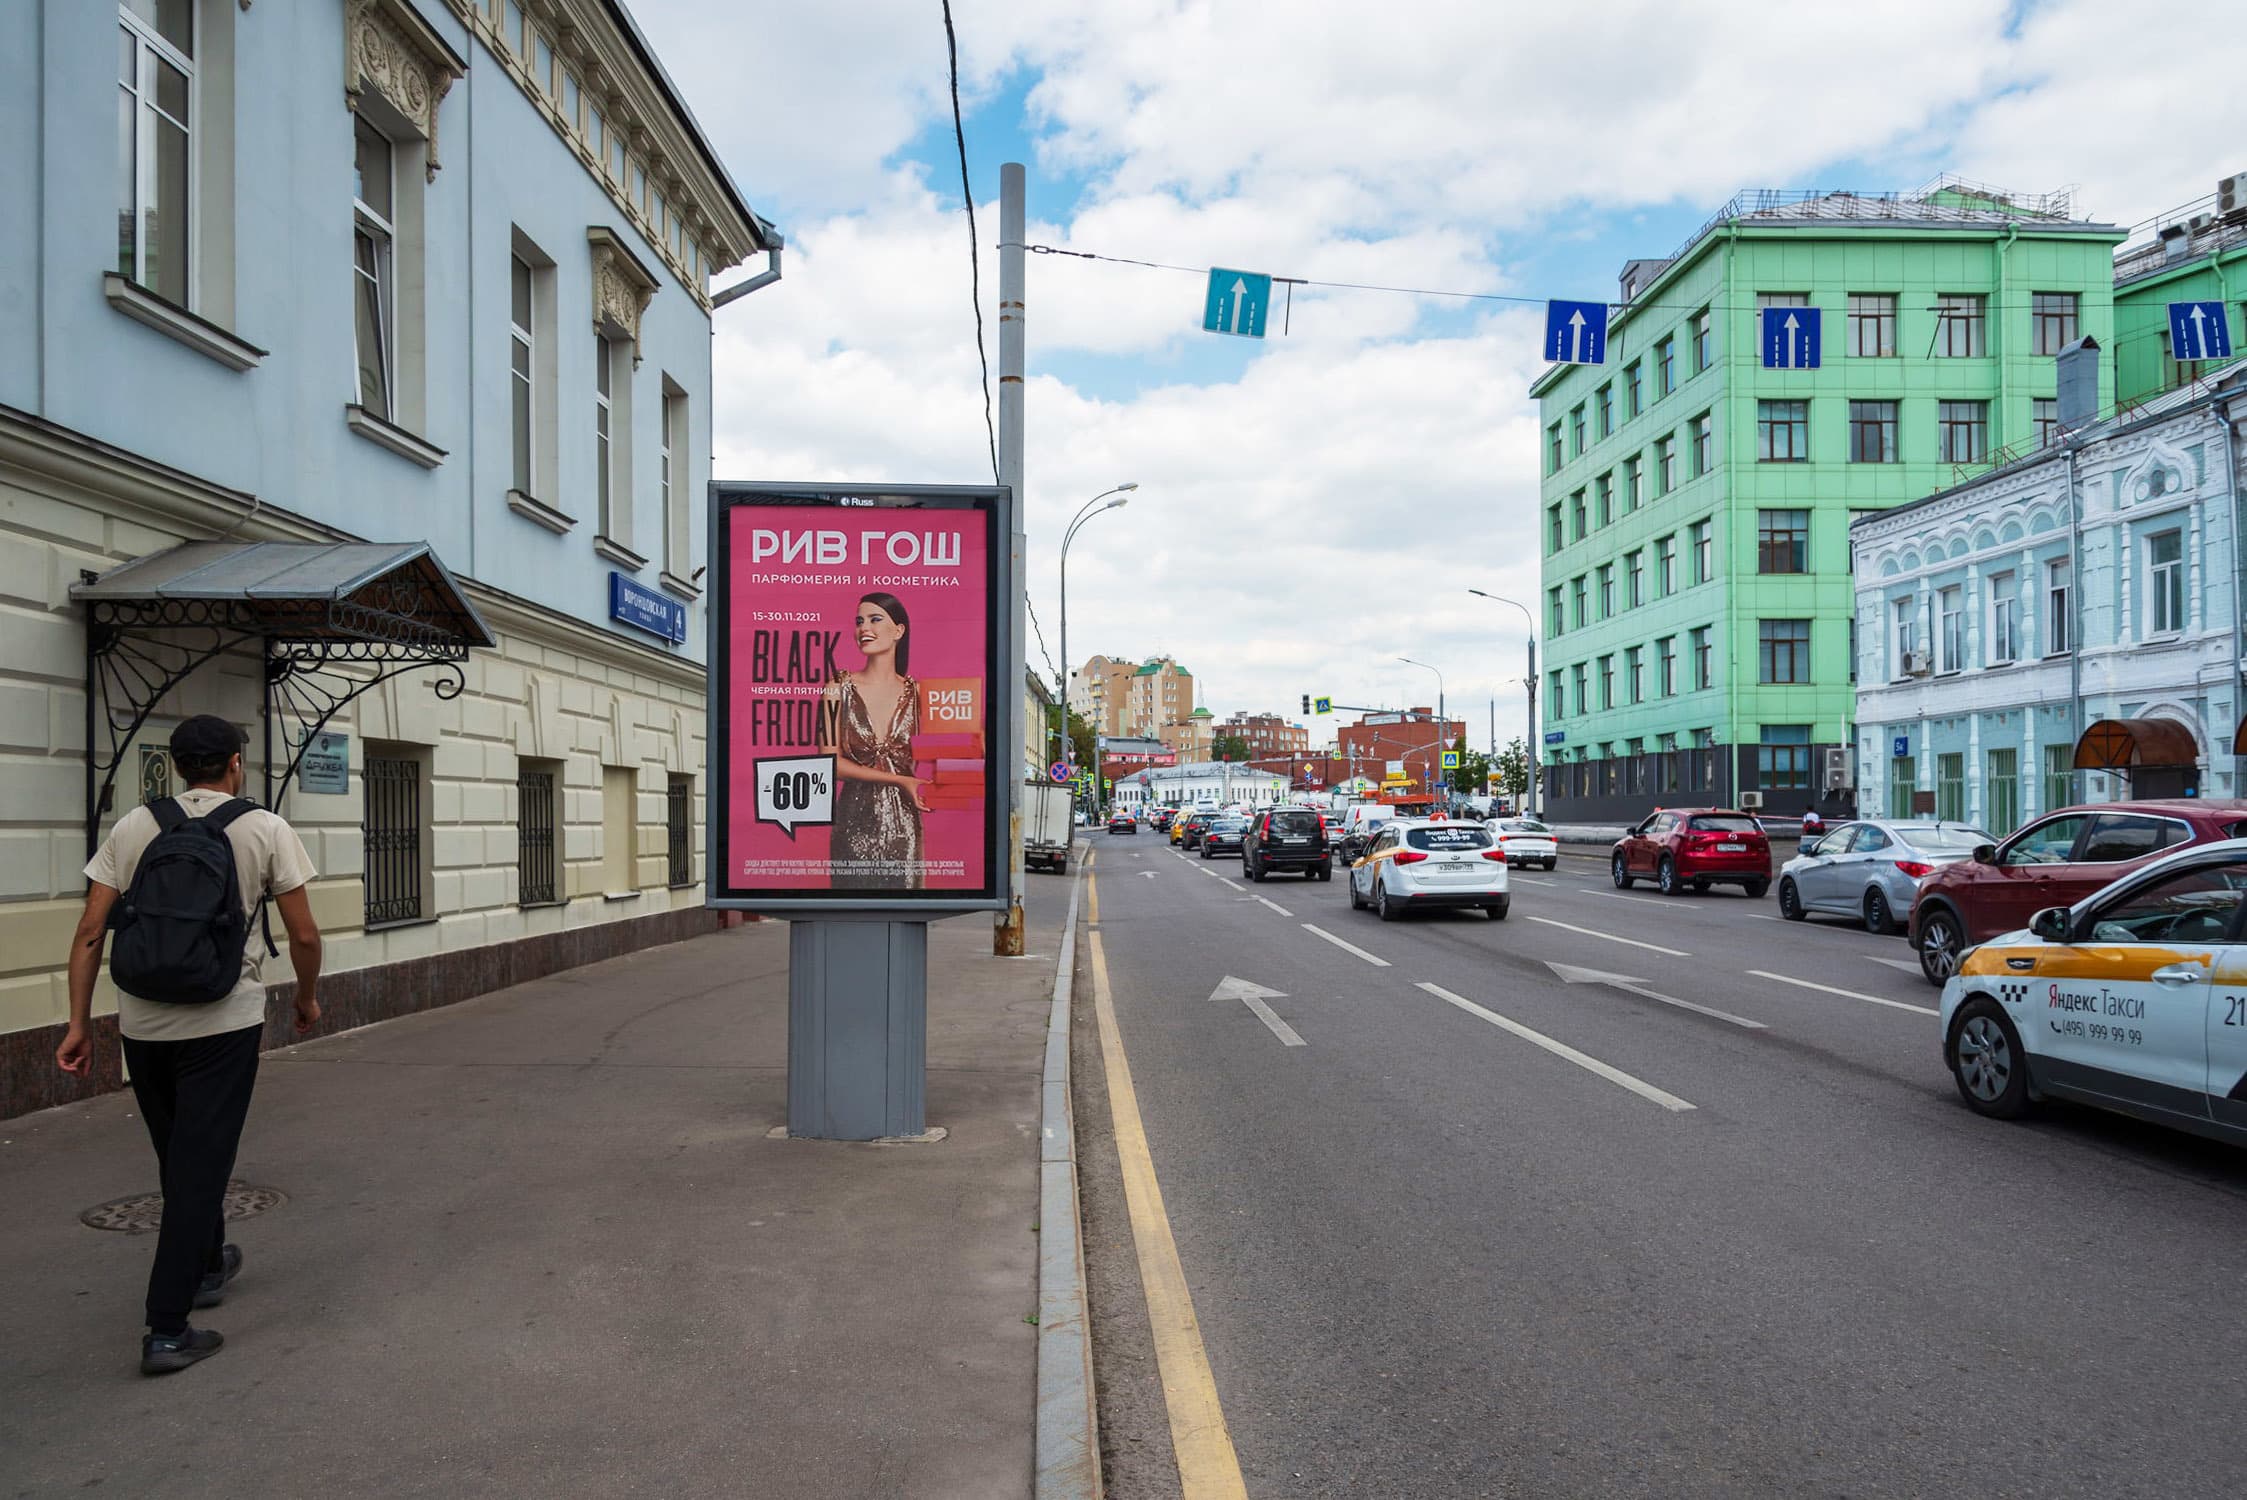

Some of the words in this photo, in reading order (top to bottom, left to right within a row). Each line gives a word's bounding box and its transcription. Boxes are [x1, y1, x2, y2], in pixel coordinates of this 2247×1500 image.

[851, 497, 874, 506] Russ
[752, 529, 848, 565] РИВ
[860, 531, 961, 566] ГОШ
[751, 574, 851, 585] ПАРФЮМЕРИЯ
[857, 575, 866, 585] И
[873, 575, 960, 586] КОСМЕТИКА
[675, 609, 682, 629] 4
[752, 611, 821, 622] 15-30.11.2021
[752, 630, 841, 683] BLACK
[751, 686, 791, 695] ЧЕРНАЯ
[793, 686, 840, 696] ПЯТНИЦА
[928, 690, 972, 705] РИВ
[752, 699, 840, 746] FRIDAY
[929, 706, 972, 721] ГОШ
[763, 771, 827, 811] -60%
[2049, 984, 2098, 1012] Яндекс
[2101, 988, 2145, 1019] Такси
[2062, 1019, 2086, 1039] (495)
[2089, 1024, 2108, 1040] 999
[2111, 1027, 2125, 1042] 99
[2128, 1030, 2142, 1045] 99
